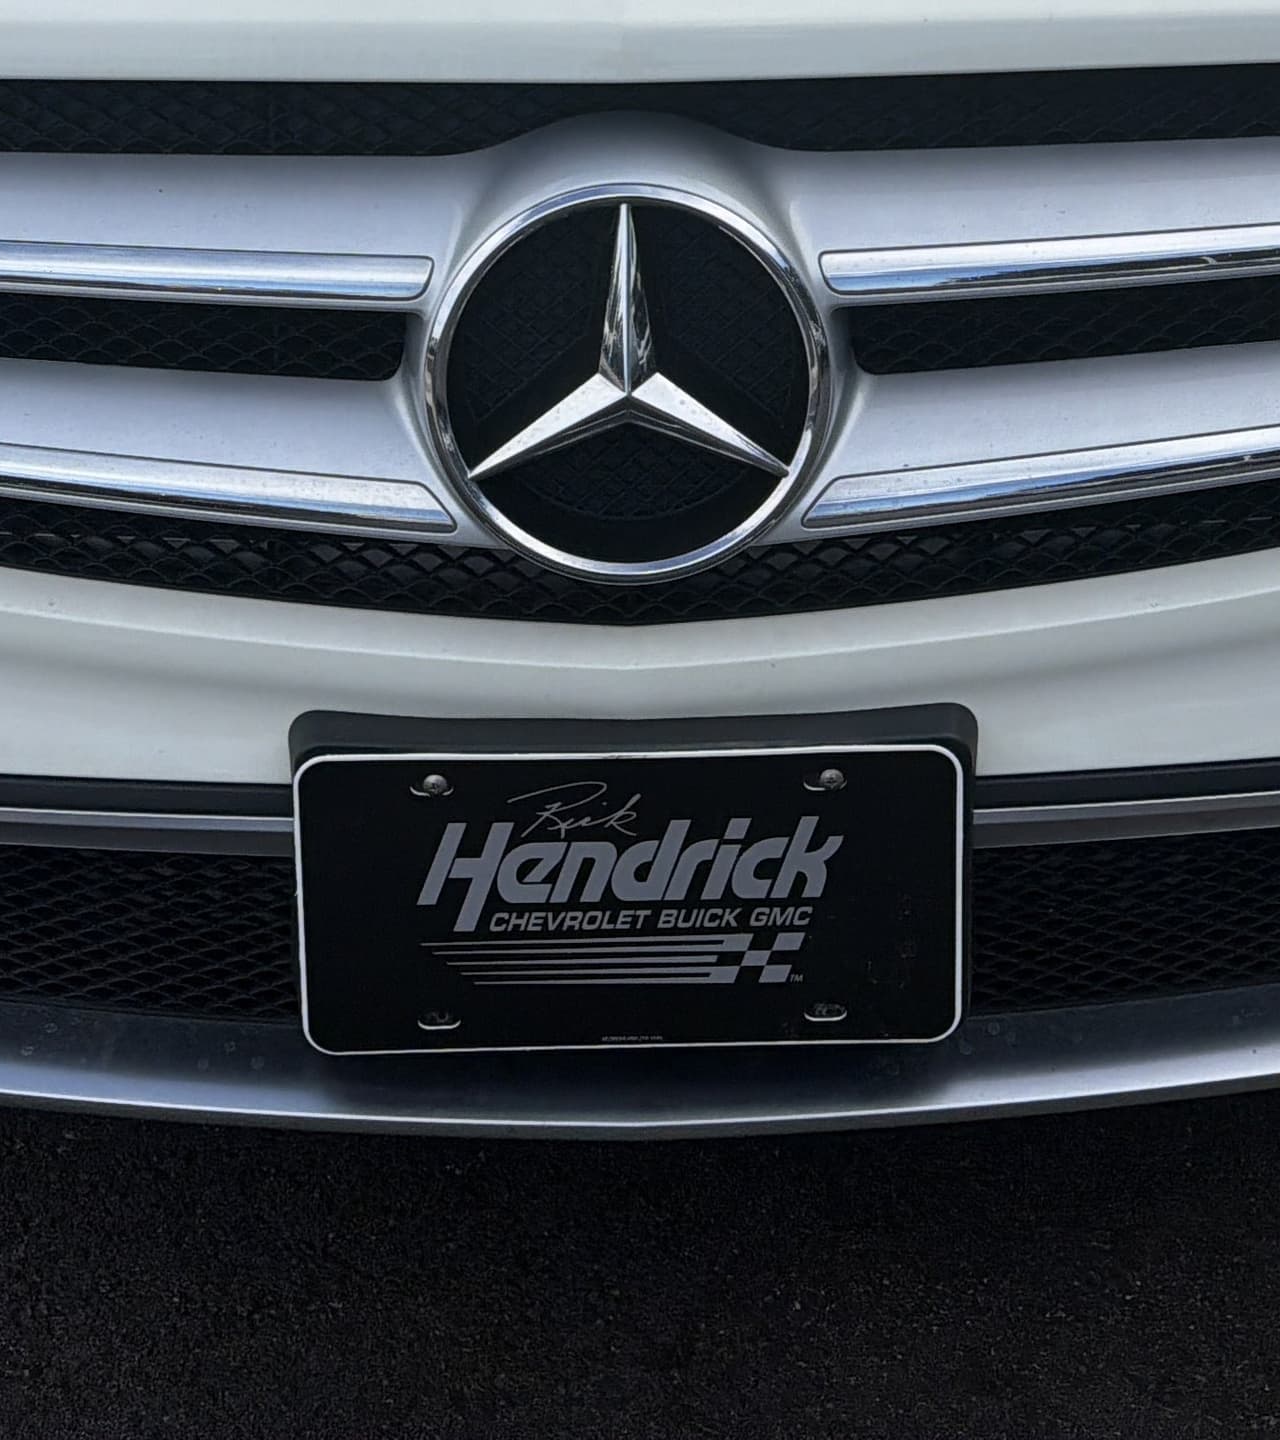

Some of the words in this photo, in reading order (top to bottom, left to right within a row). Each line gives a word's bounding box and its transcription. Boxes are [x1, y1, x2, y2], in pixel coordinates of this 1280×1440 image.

[416, 816, 844, 932] Hendrick
[489, 910, 651, 932] CHEVROLET
[658, 907, 740, 929] BUICK
[749, 905, 813, 927] GMC
